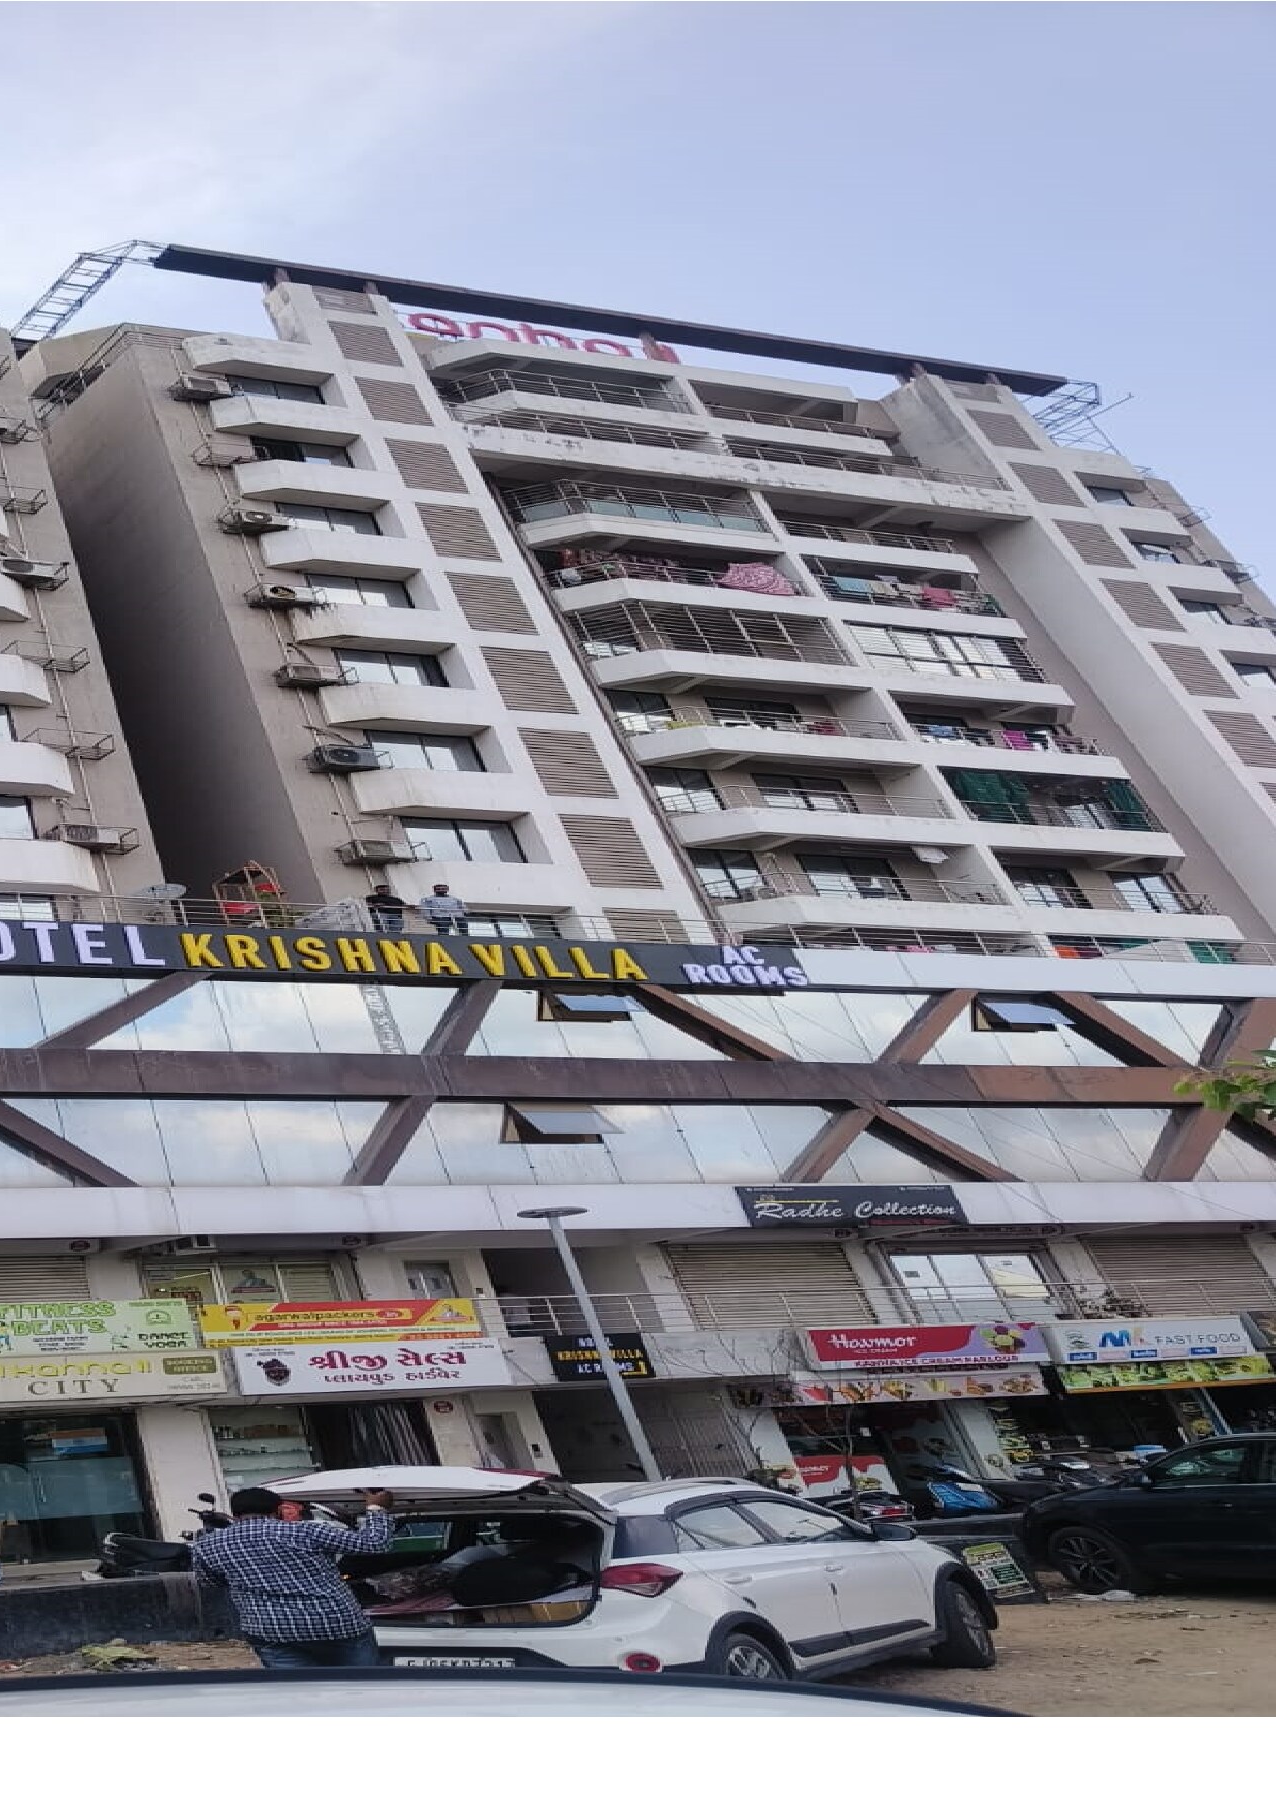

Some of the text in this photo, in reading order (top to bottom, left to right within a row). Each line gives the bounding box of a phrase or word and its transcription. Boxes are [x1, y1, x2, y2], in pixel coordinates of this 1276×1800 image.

[180, 932, 463, 976] KRISHNA
[467, 943, 650, 981] VILLA
[722, 945, 765, 965] AC
[681, 963, 809, 987] ROOMS
[754, 1200, 956, 1219] Radhe Collection
[11, 1318, 108, 1336] BEATS
[1154, 1333, 1241, 1345] FAST FOOD
[27, 1378, 120, 1395] CITY
